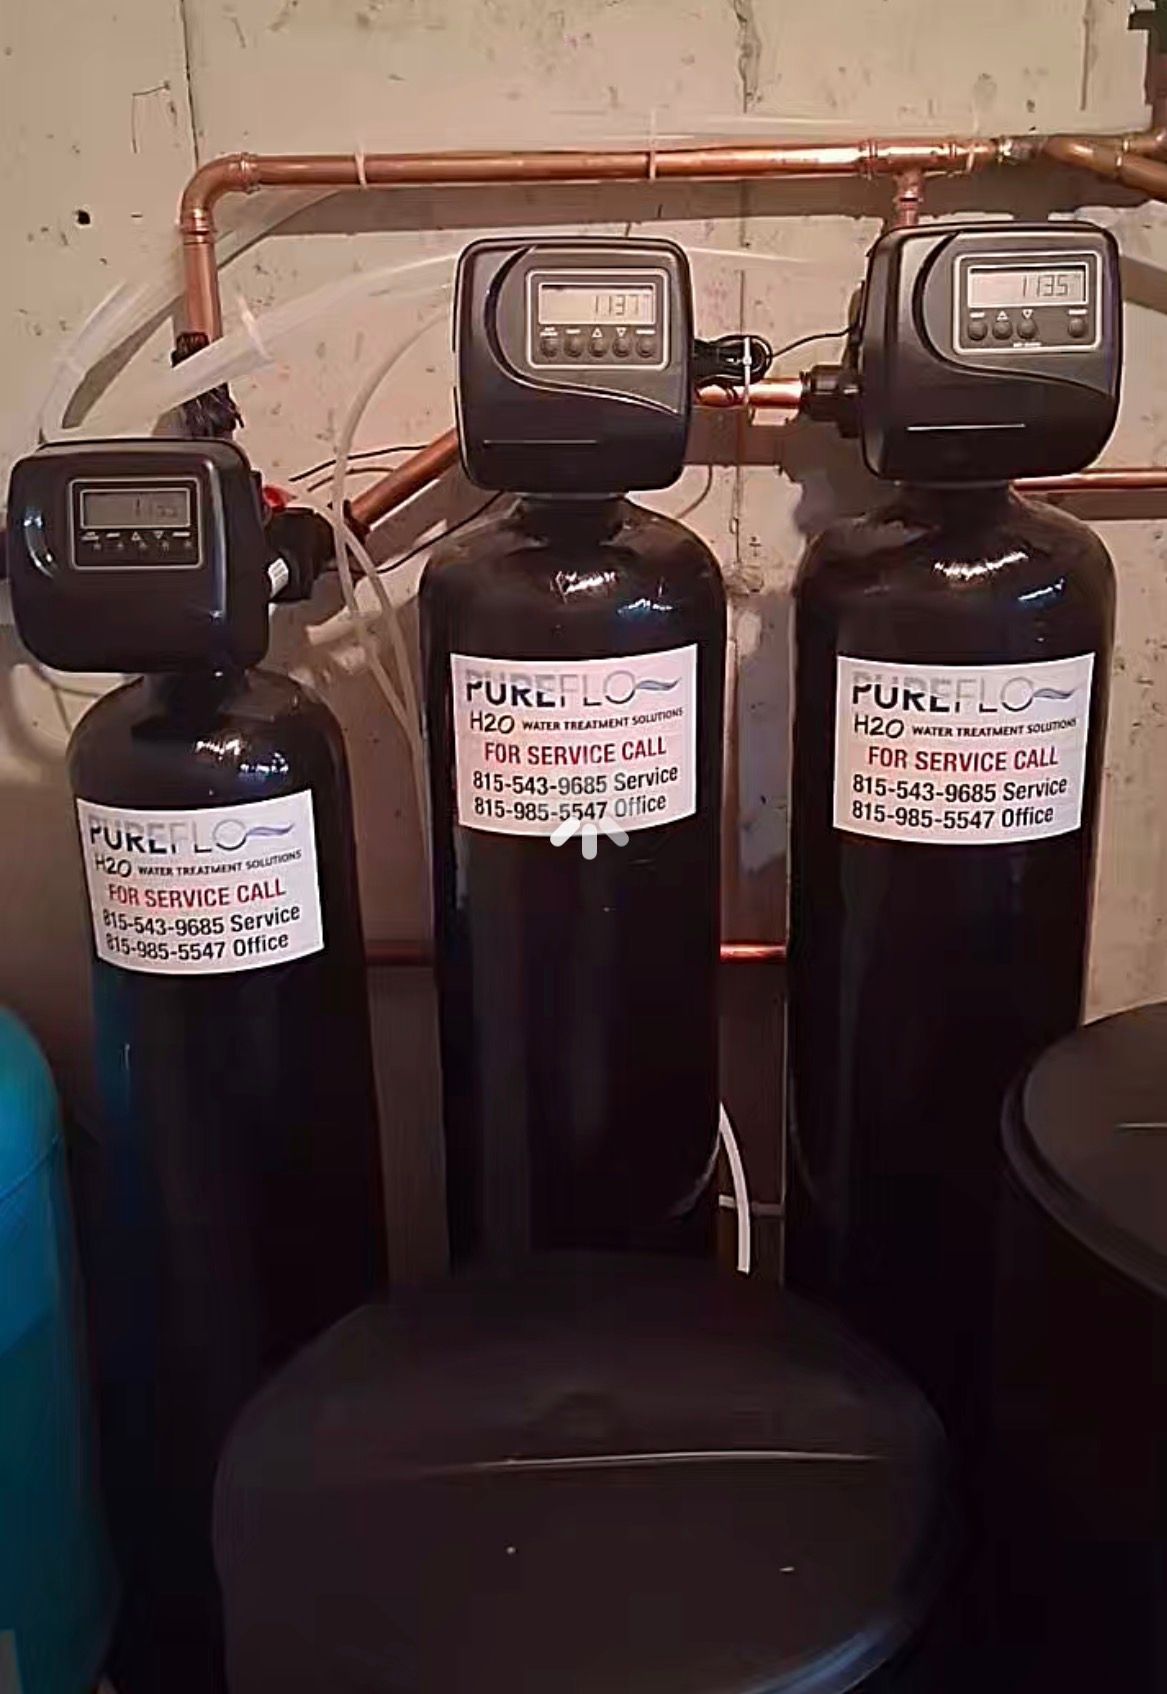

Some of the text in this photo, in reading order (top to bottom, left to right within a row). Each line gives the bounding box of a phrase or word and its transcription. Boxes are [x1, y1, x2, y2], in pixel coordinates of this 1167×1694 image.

[466, 669, 635, 708] PUREFLO
[852, 672, 1034, 713] PUREFLO
[470, 708, 683, 733] H2O WATER TREATMENT SOLUTIONS
[854, 715, 1076, 738] H2O WATER TREATMENT SOLUTIONS
[485, 737, 666, 765] FOR SERVICE CALL
[869, 746, 1058, 771] FOR SERVICE CALL
[473, 767, 678, 795] 815-543-9685 Service
[853, 774, 1067, 802] 815-543-9685 Service
[475, 796, 666, 820] 815-985-5547 Office
[853, 801, 1053, 829] 815-985-5547 Office
[89, 815, 247, 854] PUREFLO
[95, 850, 301, 877] H2O WATER TREATMENT SOLUTIONS
[108, 878, 286, 908] FOR SERVICE CALL
[103, 905, 300, 936] 815-543-9685 Service
[106, 933, 289, 960] 815-985-5547 Office
